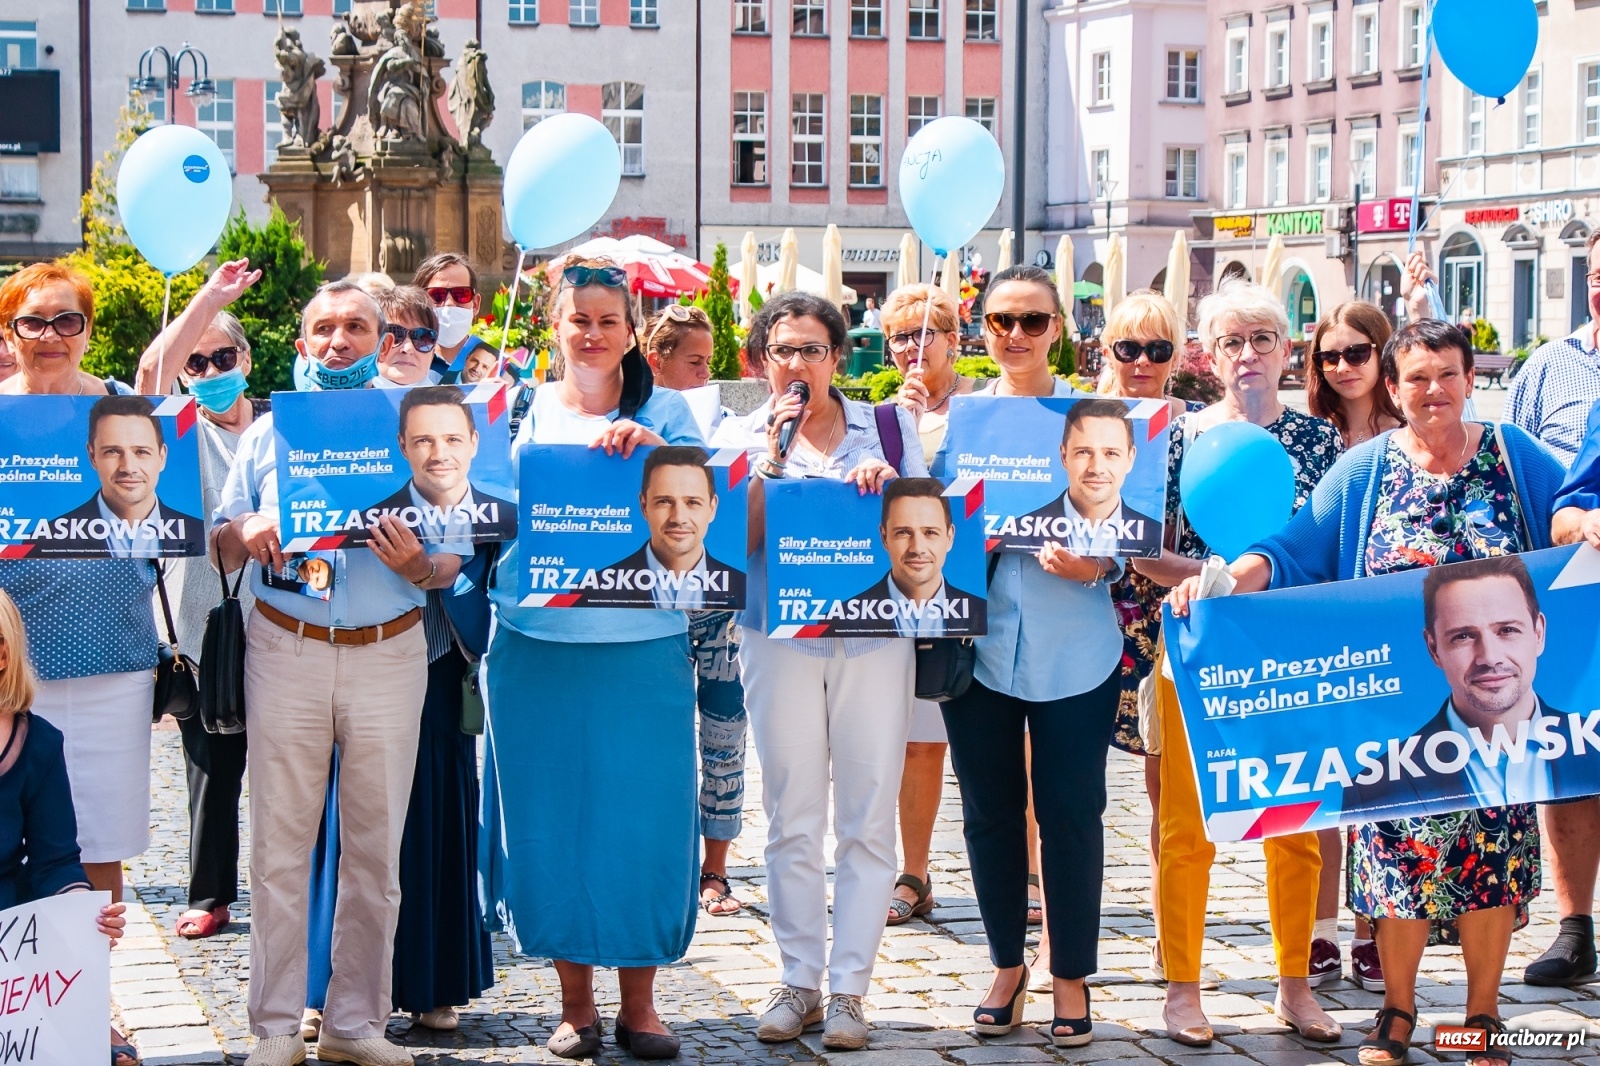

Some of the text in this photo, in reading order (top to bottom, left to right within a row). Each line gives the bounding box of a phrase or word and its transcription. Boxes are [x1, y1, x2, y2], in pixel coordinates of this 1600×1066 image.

[1266, 211, 1323, 236] KANTOR
[12, 454, 79, 468] Prezydent
[288, 447, 389, 464] Silny Prezydent
[958, 453, 1050, 468] Silny Prezydent
[40, 469, 82, 481] Polska
[289, 461, 393, 478] Wspólna Polska
[1012, 469, 1052, 482] Polska
[0, 506, 15, 516] AŁ
[291, 499, 327, 510] RAFAŁ
[531, 504, 630, 518] Silny Prezydent
[531, 519, 633, 533] Wspólna Polska
[778, 537, 872, 550] Silny Prezydent
[530, 556, 565, 566] RAFAŁ
[779, 552, 874, 566] Wspólna Polska
[529, 568, 729, 592] TRZASKOWSKI
[779, 588, 812, 598] RAFAŁ
[778, 597, 970, 621] TRZASKOWSKI
[1199, 643, 1391, 689] Silny Prezydent
[1203, 674, 1401, 720] Wspólna Polska
[1206, 747, 1237, 759] RAFAŁ
